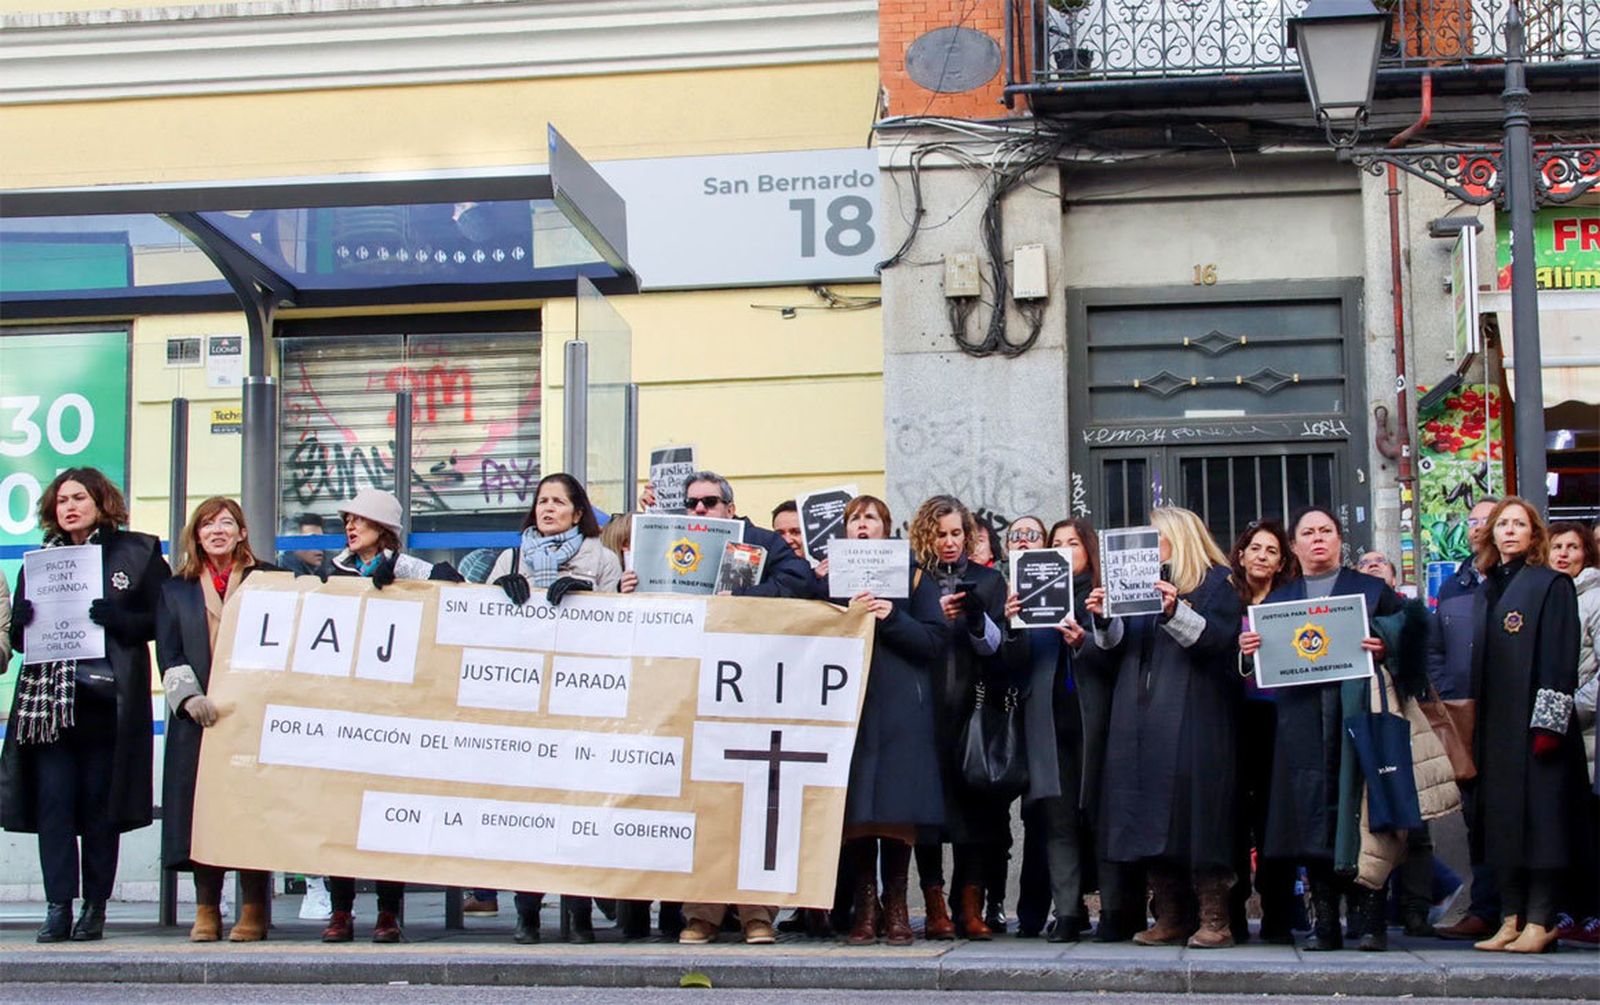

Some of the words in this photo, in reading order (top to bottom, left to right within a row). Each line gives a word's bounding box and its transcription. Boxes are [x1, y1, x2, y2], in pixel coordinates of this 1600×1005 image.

[703, 177, 749, 196] San
[757, 169, 875, 195] Bernardo
[789, 195, 875, 258] 18
[1193, 264, 1217, 285] 16
[211, 346, 239, 354] LOOMIS
[0, 393, 95, 457] 30
[46, 560, 77, 571] PACTA
[1121, 550, 1159, 566] justicia
[48, 572, 73, 582] SUNT
[37, 583, 88, 595] SERVANDA
[446, 600, 468, 613] SIN
[479, 602, 557, 620] LETRADOS
[559, 606, 614, 622] ADMON
[617, 611, 633, 623] DE
[640, 611, 694, 625] JUSTICIA
[1261, 612, 1289, 620] JUSTICIA
[55, 621, 69, 630] LO
[42, 631, 86, 643] PACTADO
[46, 642, 81, 651] OBLIGA
[1279, 668, 1309, 676] HUELGA
[1311, 662, 1353, 672] INDEFINIDA
[462, 664, 540, 685] JUSTICIA
[555, 672, 627, 690] PARADA
[270, 720, 301, 735] POR
[306, 723, 324, 737] LA
[337, 725, 411, 746] INACCIÓN
[420, 734, 449, 750] DEL
[454, 735, 532, 753] MINISTERIO
[537, 743, 559, 758] DE
[575, 746, 596, 761] IN-
[609, 749, 676, 766] JUSTICIA
[385, 808, 421, 823] CON
[444, 812, 463, 826] LA
[481, 813, 556, 829] BENDICIÓN
[571, 820, 600, 836] DEL
[613, 823, 692, 840] GOBIERNO
